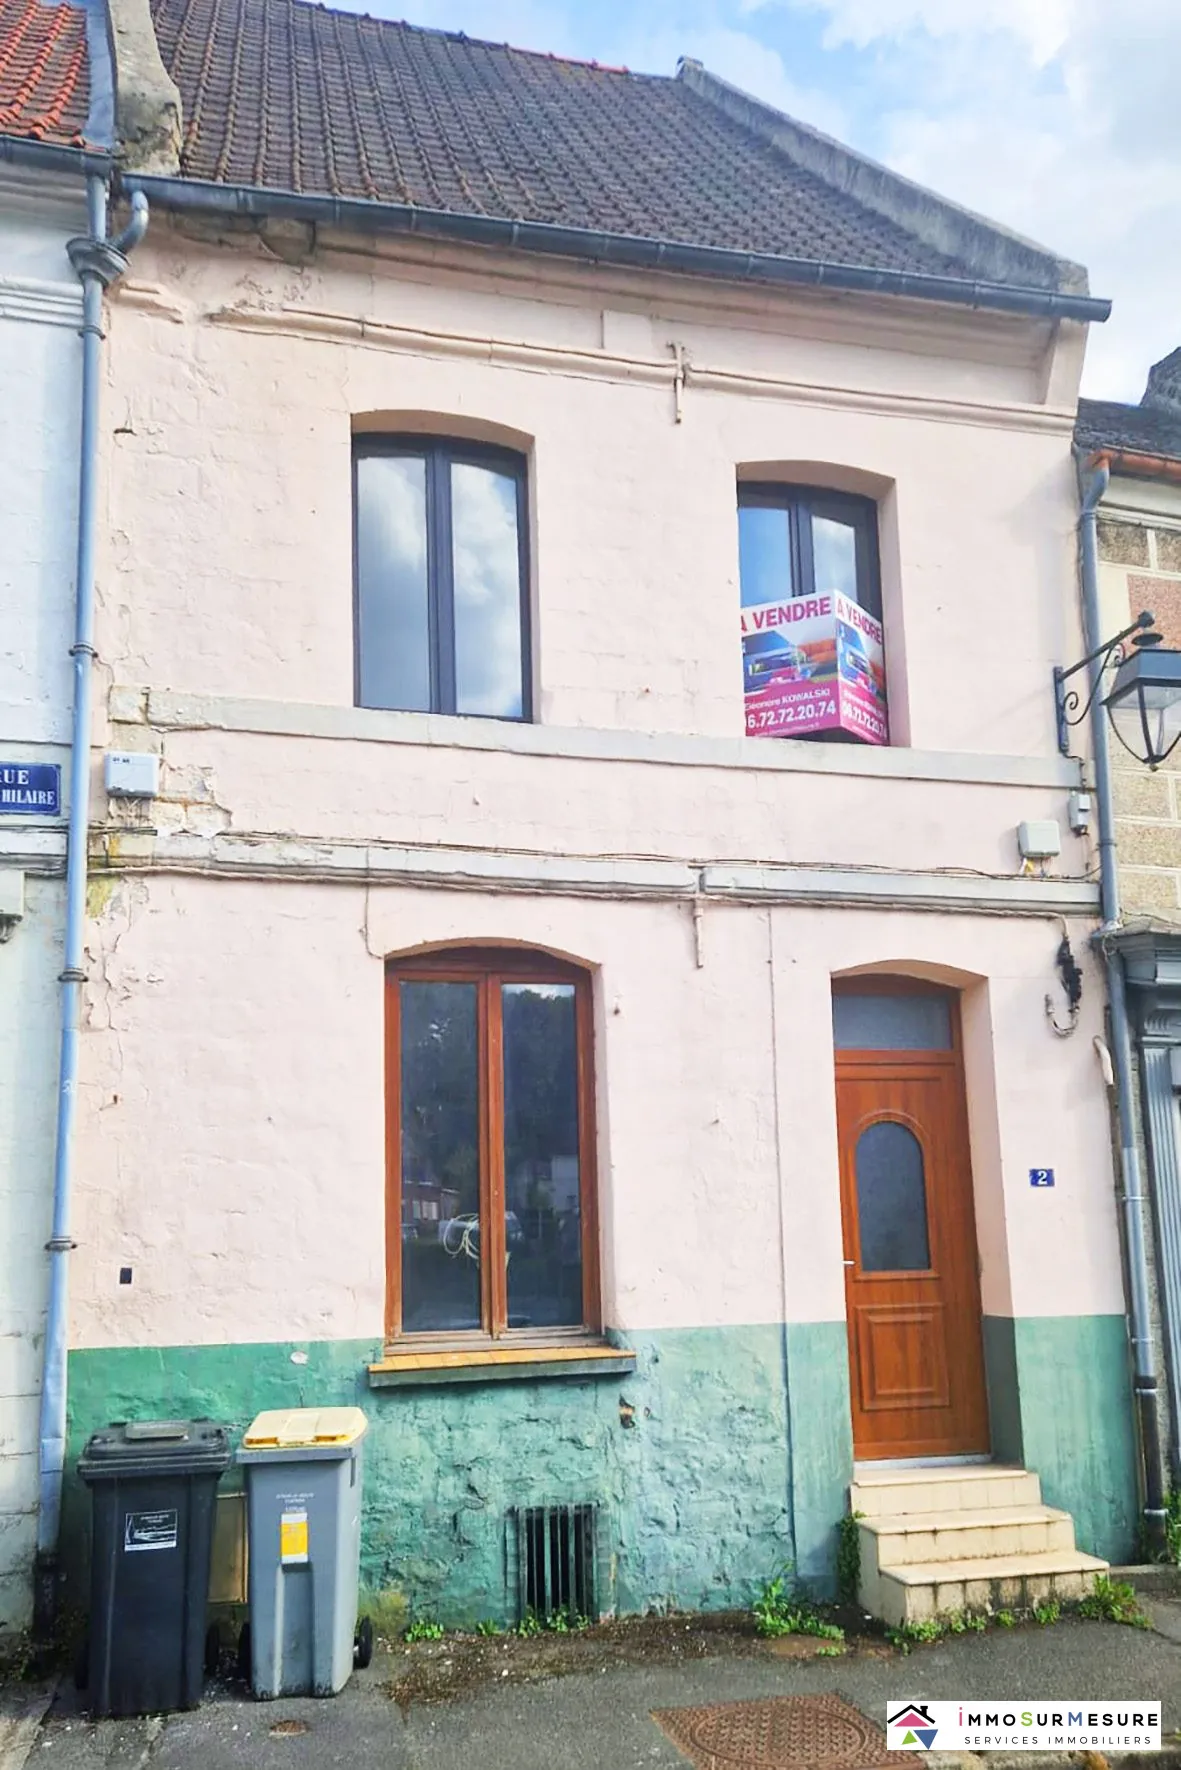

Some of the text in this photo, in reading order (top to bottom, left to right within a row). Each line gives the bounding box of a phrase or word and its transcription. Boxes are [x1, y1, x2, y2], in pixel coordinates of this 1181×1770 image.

[753, 596, 831, 629] VENDRE
[837, 599, 882, 645] A VENDRE
[0, 769, 29, 785] UE
[2, 789, 55, 805] HILAIRE
[1037, 1170, 1048, 1185] 2
